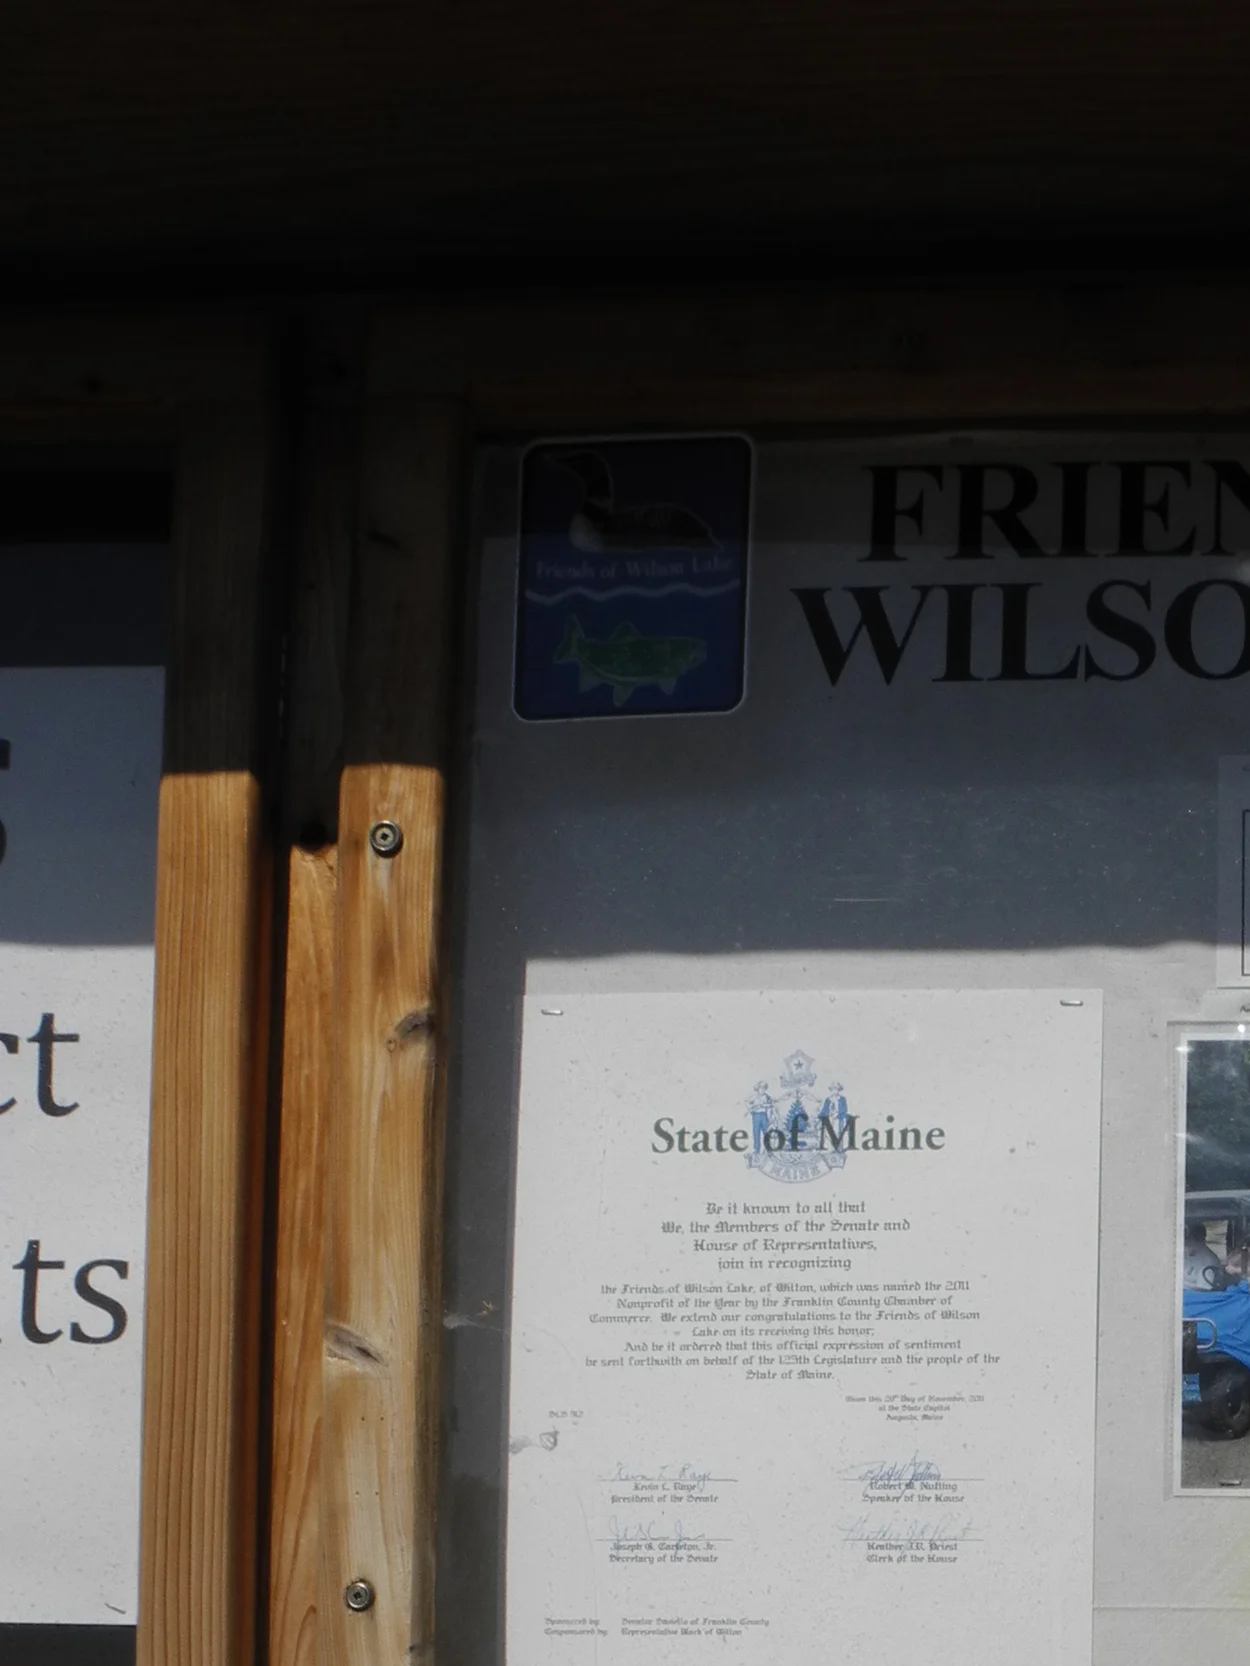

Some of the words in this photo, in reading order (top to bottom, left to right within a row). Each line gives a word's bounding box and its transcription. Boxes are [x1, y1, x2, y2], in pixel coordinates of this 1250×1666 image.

[651, 1115, 750, 1154] State
[763, 1114, 811, 1153] of
[817, 1114, 946, 1152] Maine
